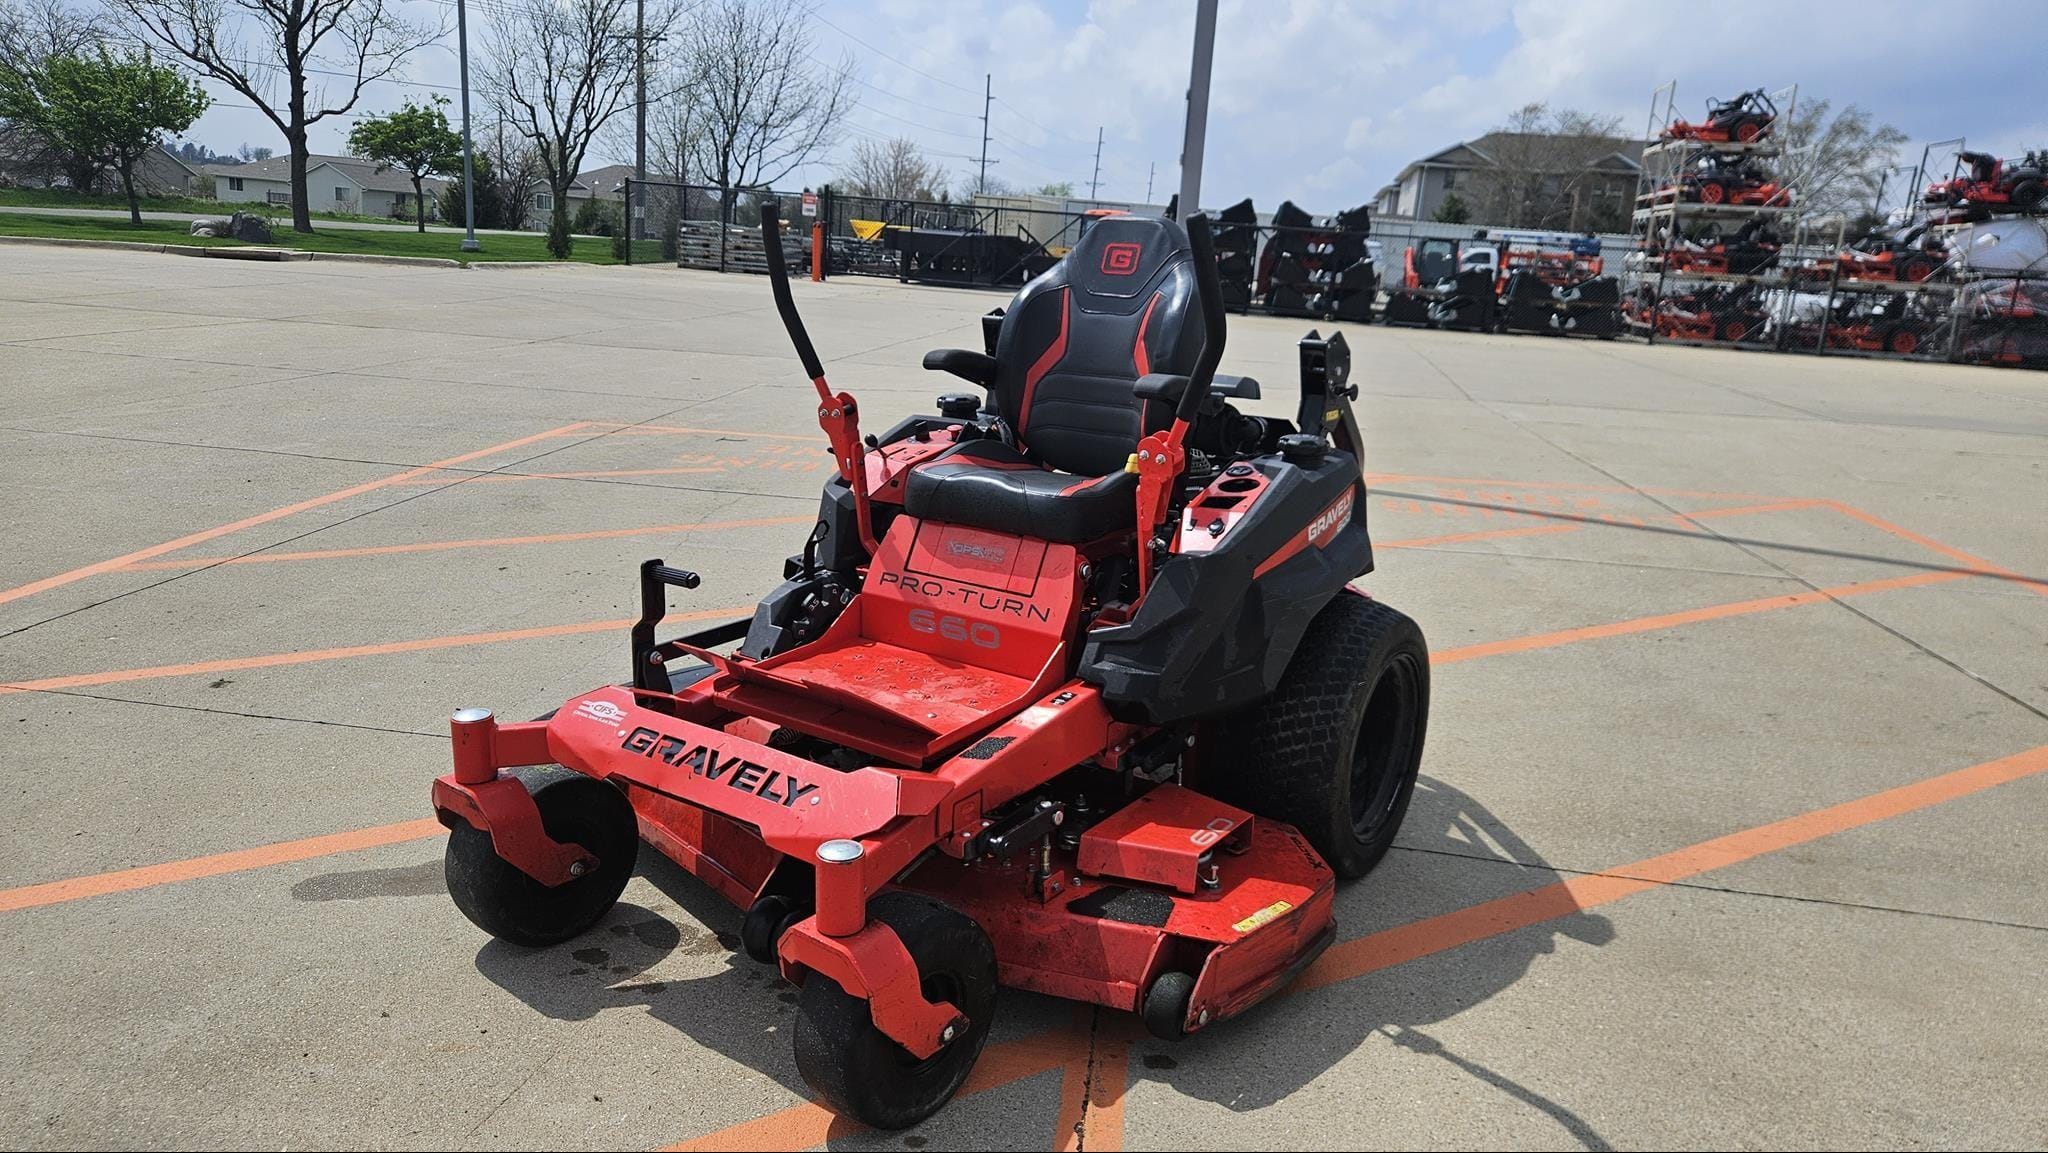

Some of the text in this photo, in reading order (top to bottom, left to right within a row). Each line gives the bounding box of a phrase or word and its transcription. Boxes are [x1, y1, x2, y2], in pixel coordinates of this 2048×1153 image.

[1308, 489, 1352, 541] GRAVELY
[880, 572, 1050, 622] PRO-TURN
[909, 608, 1000, 649] 660
[593, 704, 615, 715] CIFS
[622, 726, 820, 808] GRAVELY
[1190, 817, 1233, 846] 60
